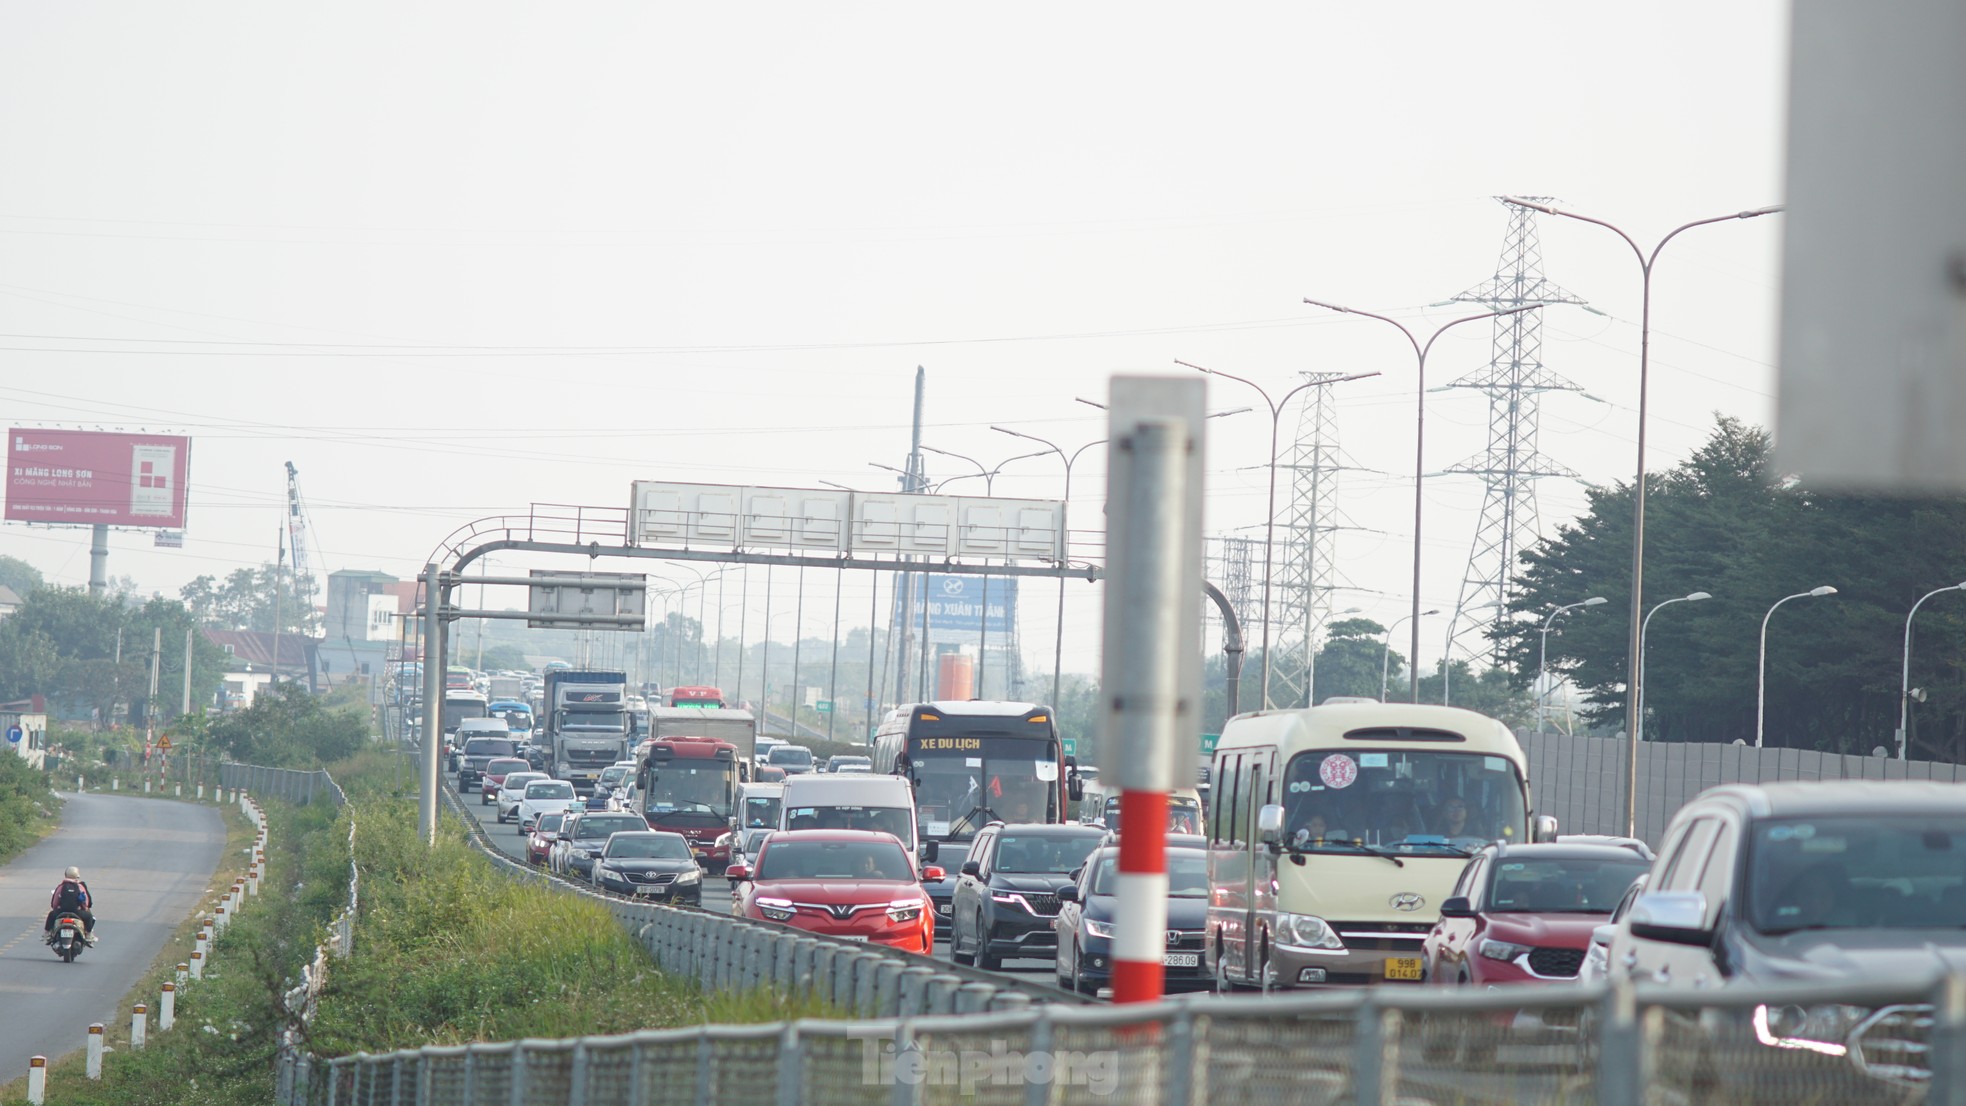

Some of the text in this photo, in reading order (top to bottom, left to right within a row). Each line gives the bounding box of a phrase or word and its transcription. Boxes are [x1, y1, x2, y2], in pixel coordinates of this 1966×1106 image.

[14, 467, 22, 476] XI
[25, 466, 49, 477] MĂNG
[51, 468, 73, 478] LONG
[944, 601, 972, 616] XUÂN
[920, 738, 980, 751] XE DU LỊCH
